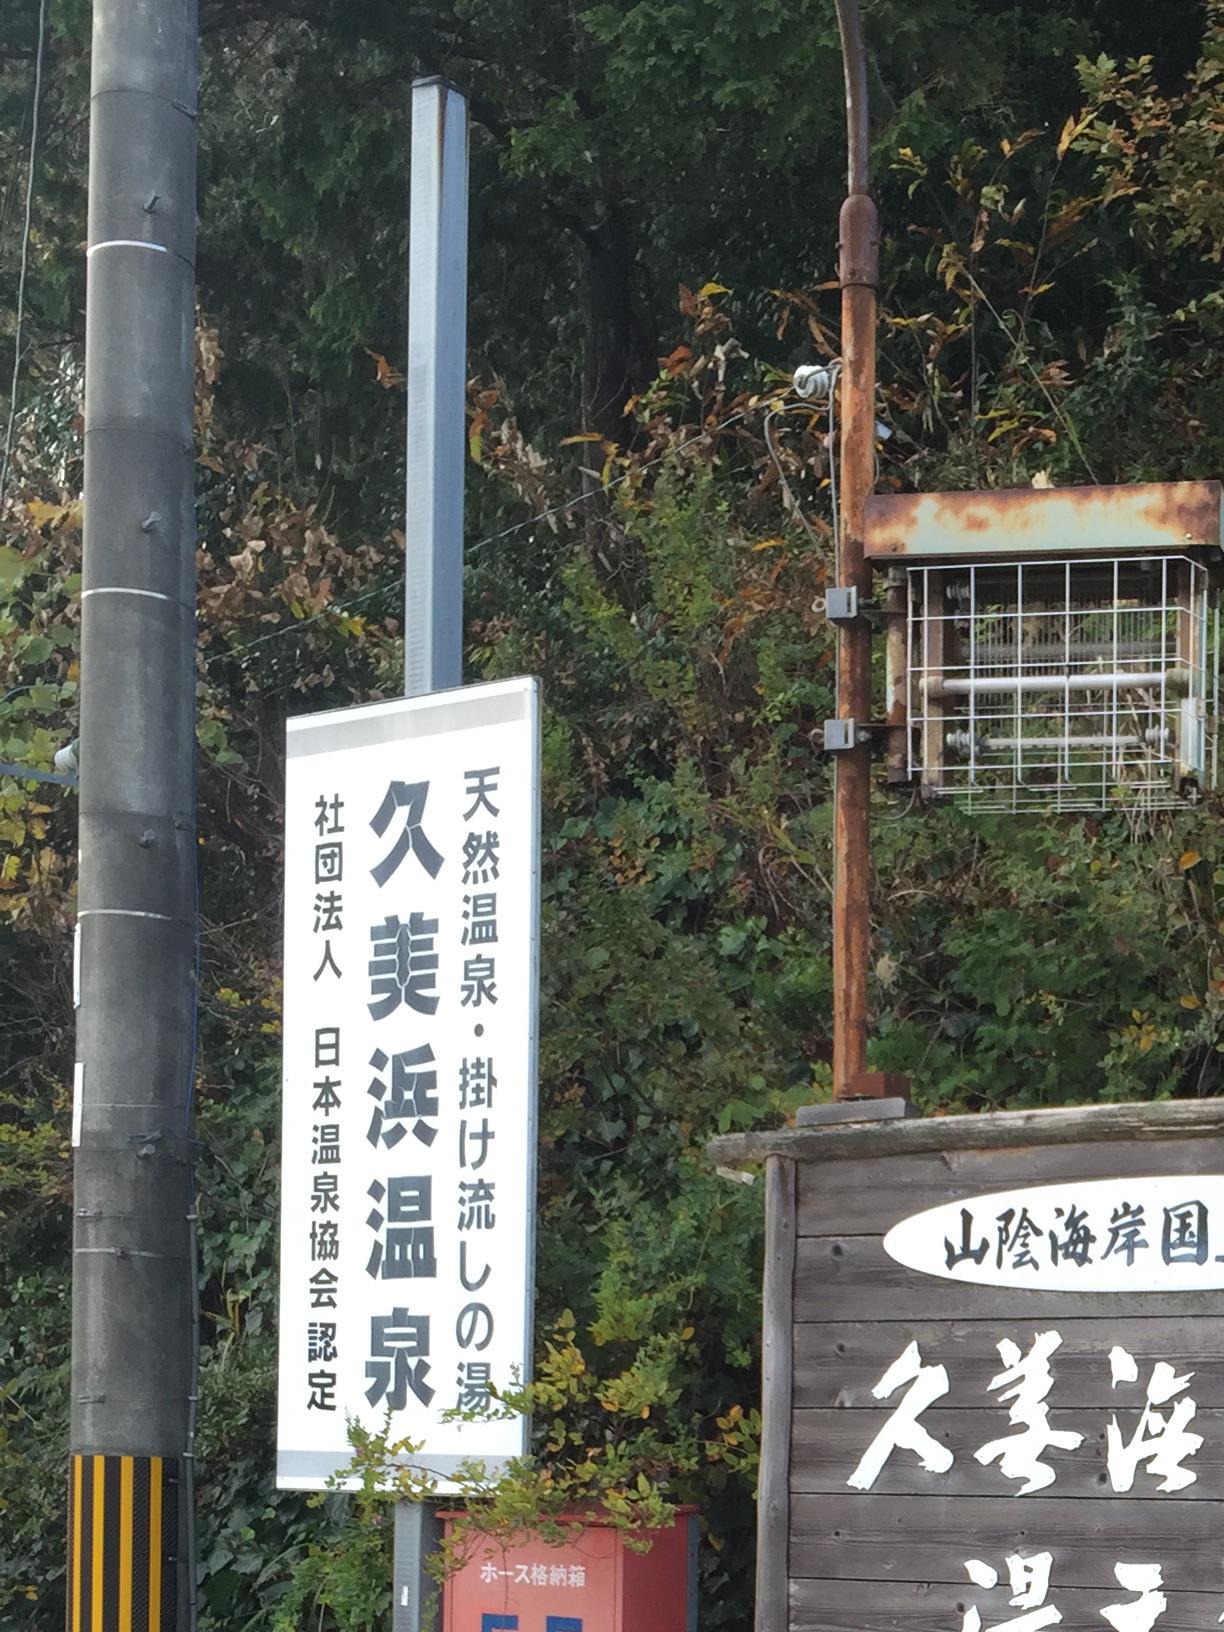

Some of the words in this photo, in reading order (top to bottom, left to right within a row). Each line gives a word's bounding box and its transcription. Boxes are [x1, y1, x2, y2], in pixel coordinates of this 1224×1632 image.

[313, 794, 345, 981] 社団法人
[307, 1027, 342, 1412] 日本温泉協会認定
[365, 780, 445, 1411] 久美浜温泉
[456, 767, 500, 1414] 天然温泉・掛け流しの湯
[480, 1562, 586, 1588] ホース格納箱
